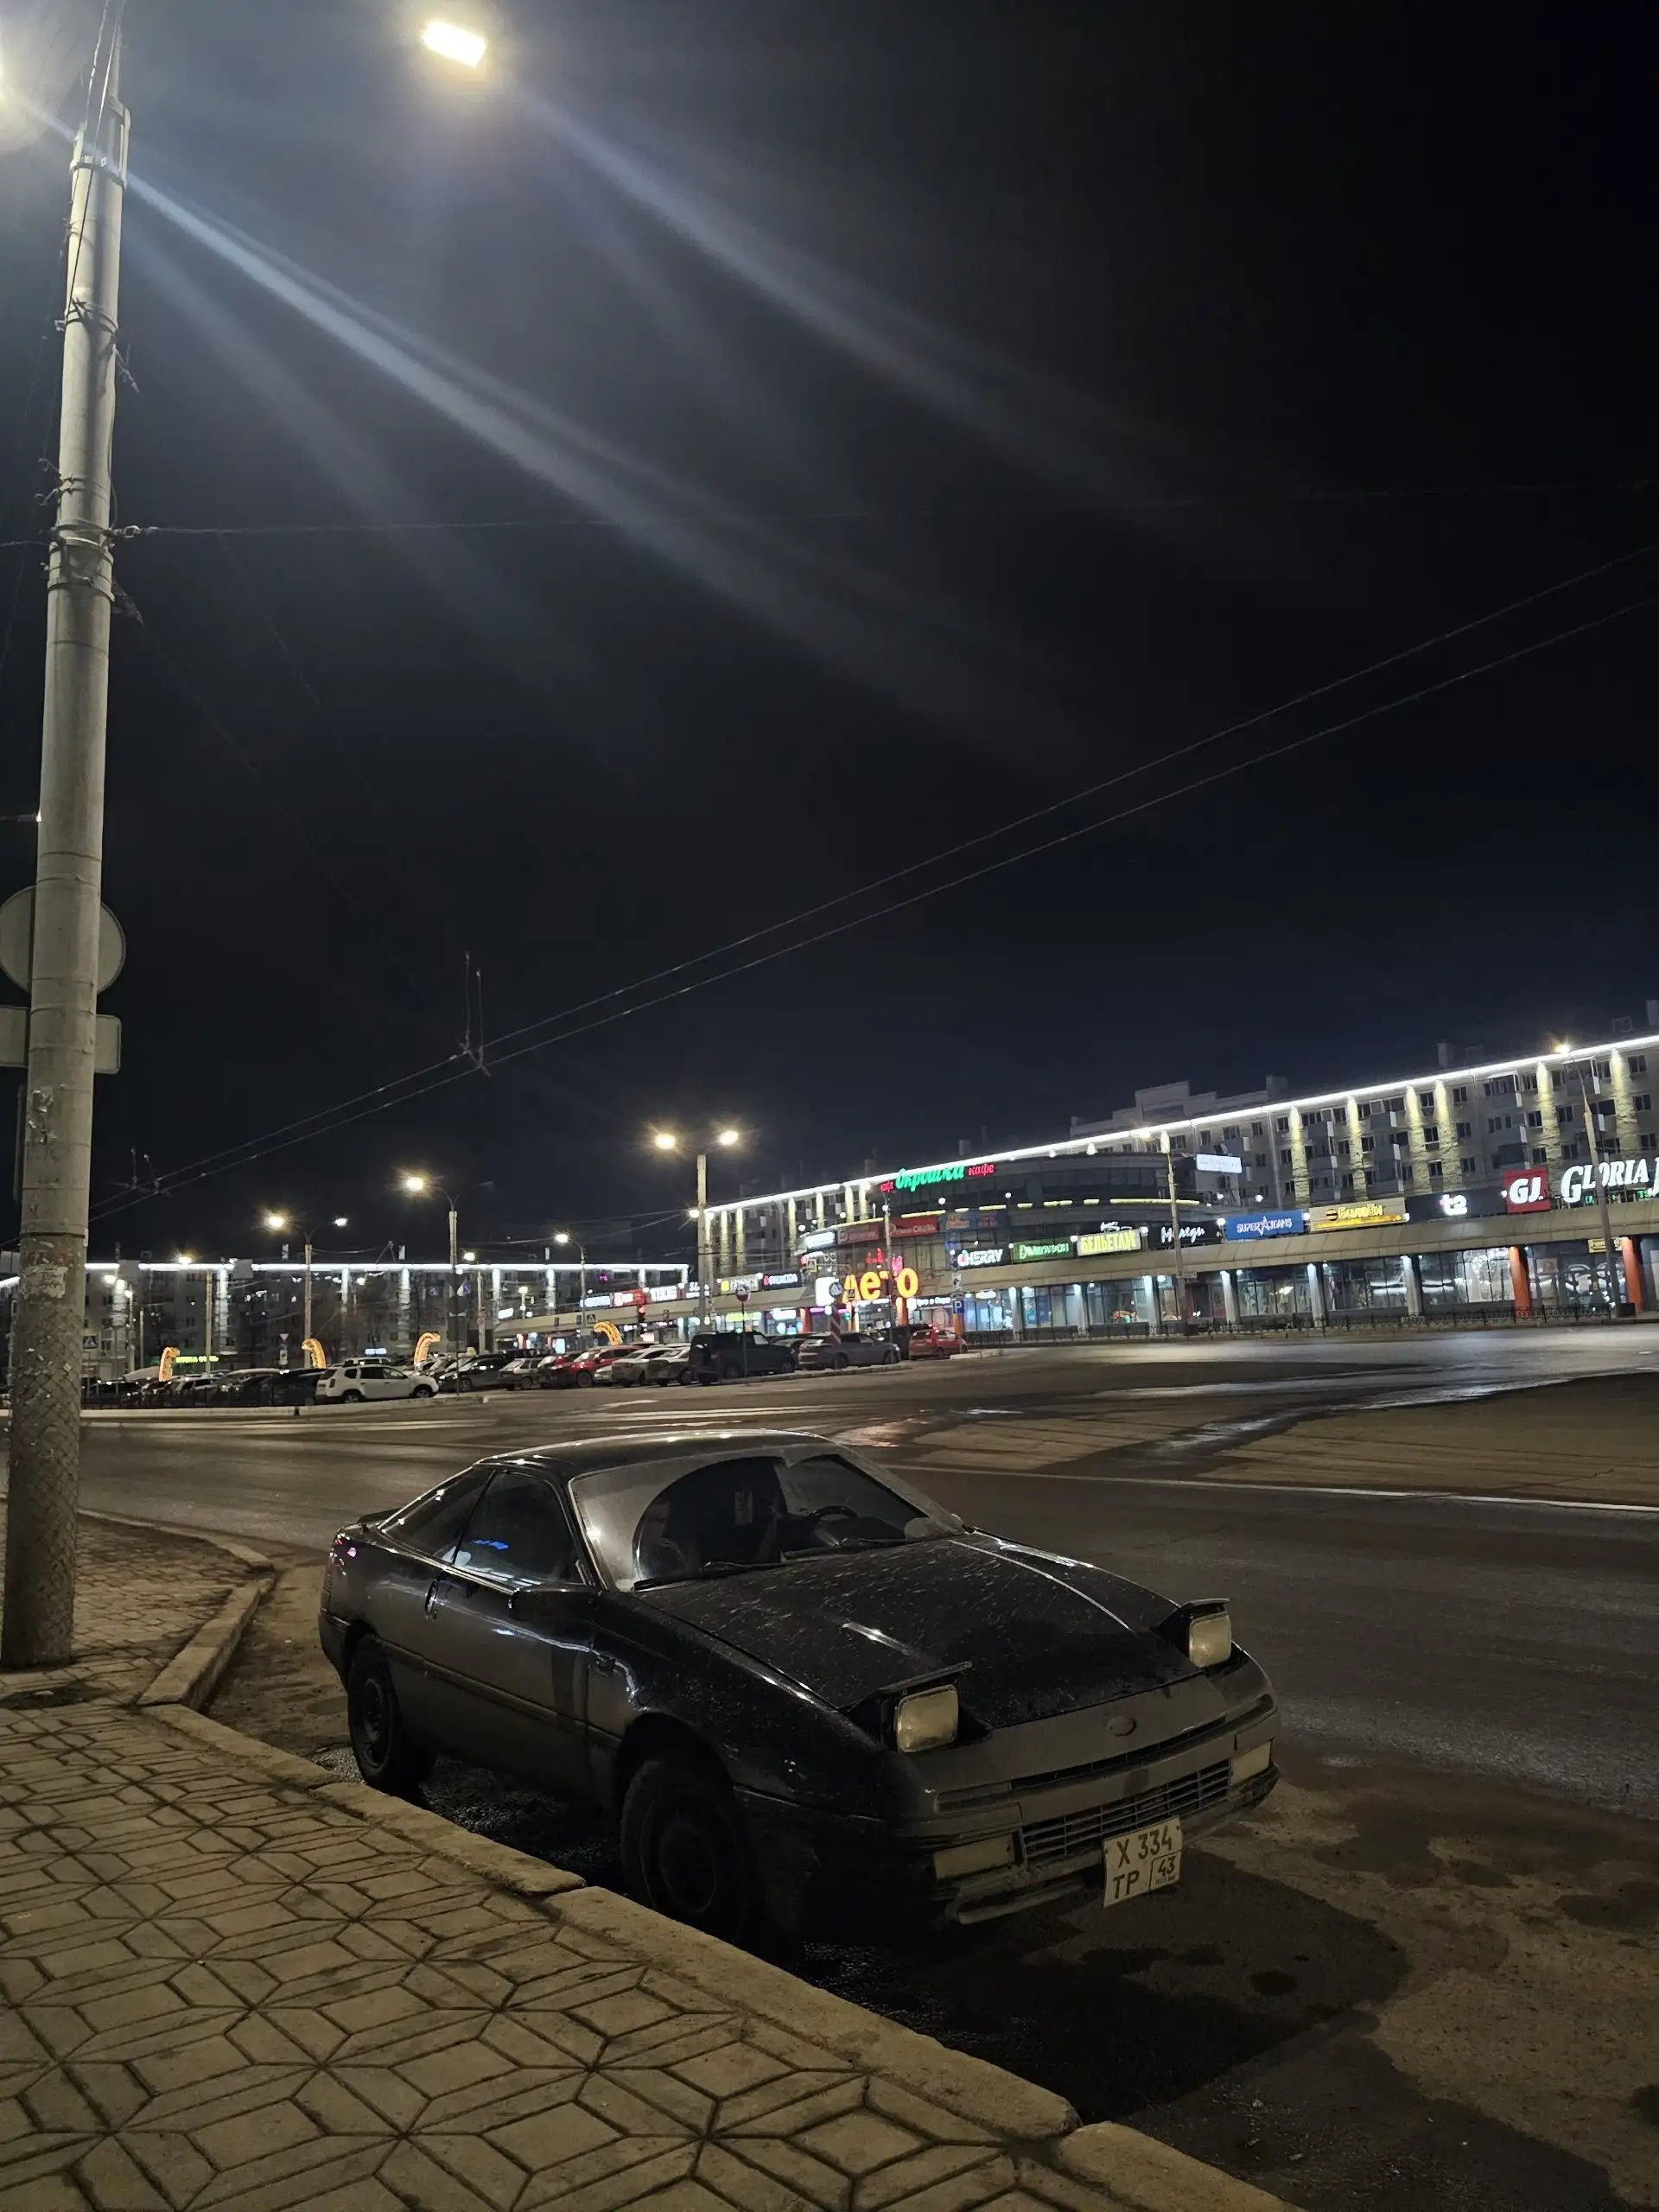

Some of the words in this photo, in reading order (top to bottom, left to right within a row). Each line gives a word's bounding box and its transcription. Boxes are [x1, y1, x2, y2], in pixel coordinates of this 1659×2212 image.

[1560, 1158, 1649, 1203] GLORIA
[1138, 1825, 1172, 1859] 334
[1158, 1855, 1176, 1877] 43
